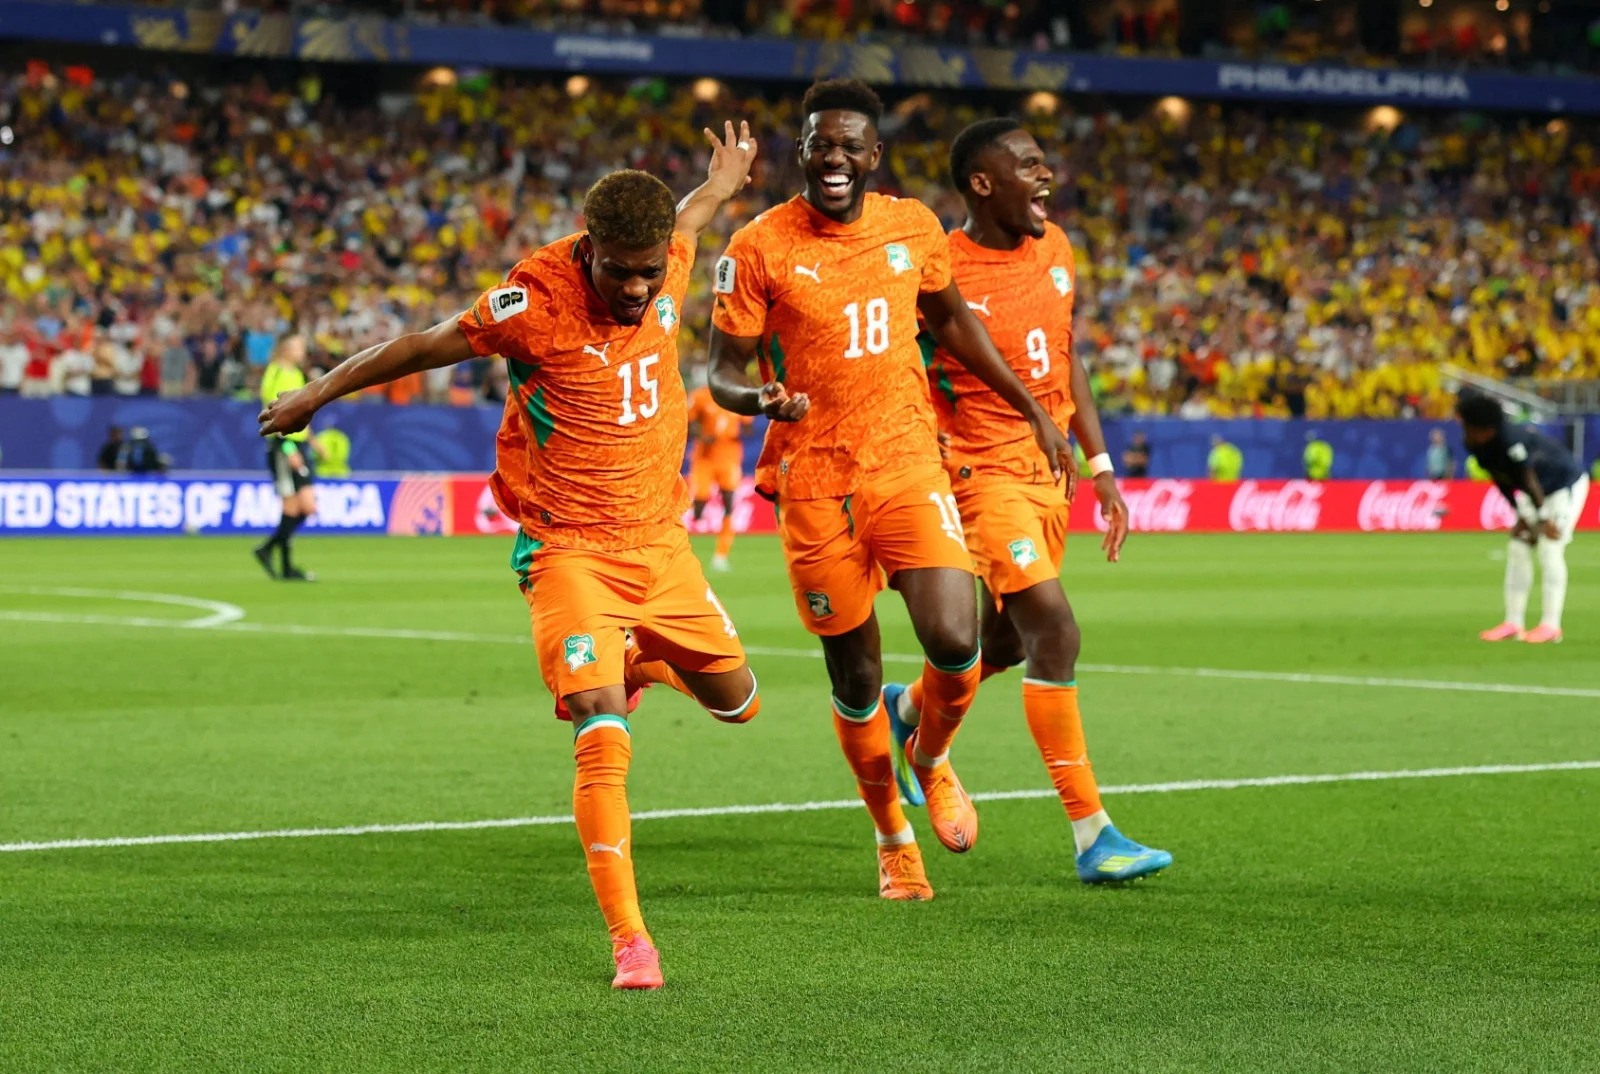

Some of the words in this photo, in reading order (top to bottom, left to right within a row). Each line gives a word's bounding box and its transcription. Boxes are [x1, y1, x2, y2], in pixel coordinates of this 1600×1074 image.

[1218, 64, 1469, 98] PHILADELPHIA
[843, 297, 890, 358] 18
[1026, 327, 1050, 380] 9
[617, 353, 659, 425] 15
[55, 482, 183, 528] STATES
[185, 483, 232, 528] OF
[231, 482, 385, 528] AMRICA
